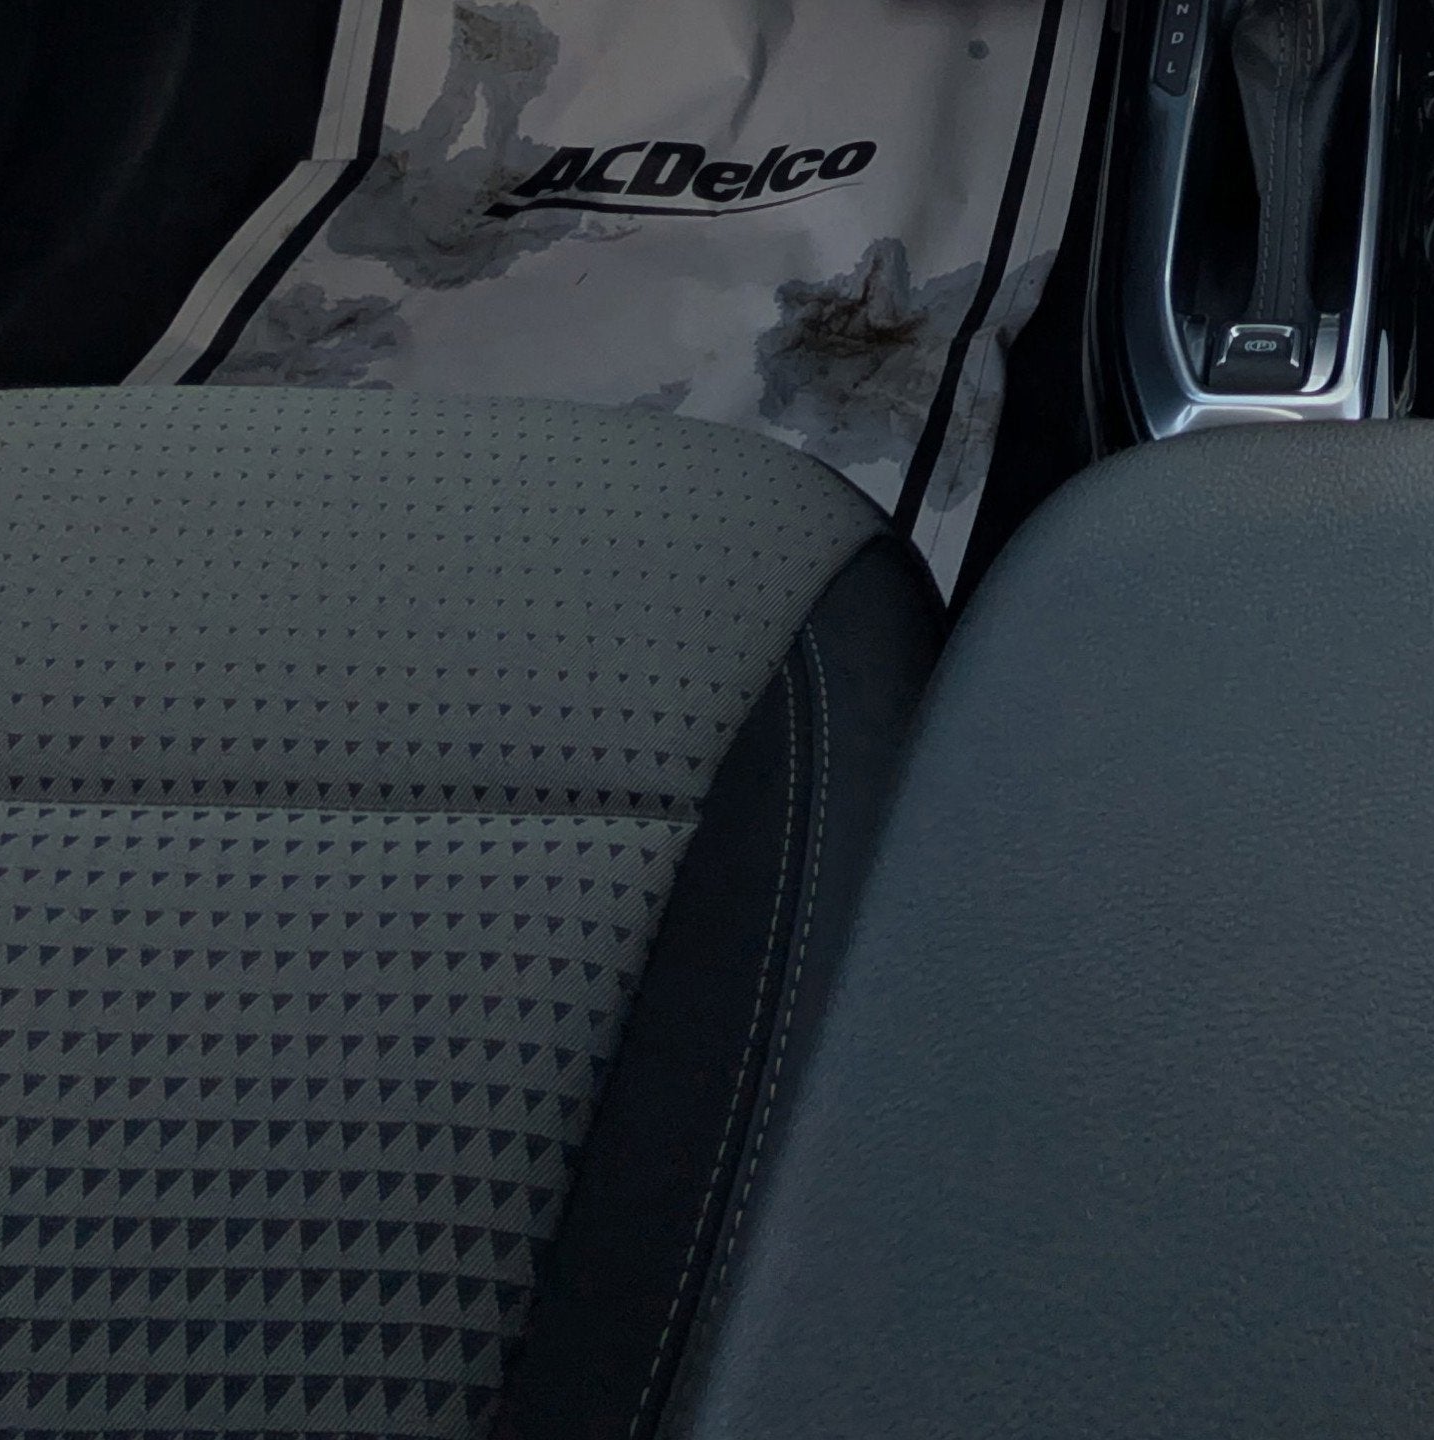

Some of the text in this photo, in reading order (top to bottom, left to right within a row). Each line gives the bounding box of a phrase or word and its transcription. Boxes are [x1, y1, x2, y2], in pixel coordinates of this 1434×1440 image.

[1176, 3, 1190, 16] N
[1171, 31, 1185, 45] D
[1166, 60, 1176, 74] L
[509, 140, 877, 203] ACDelco
